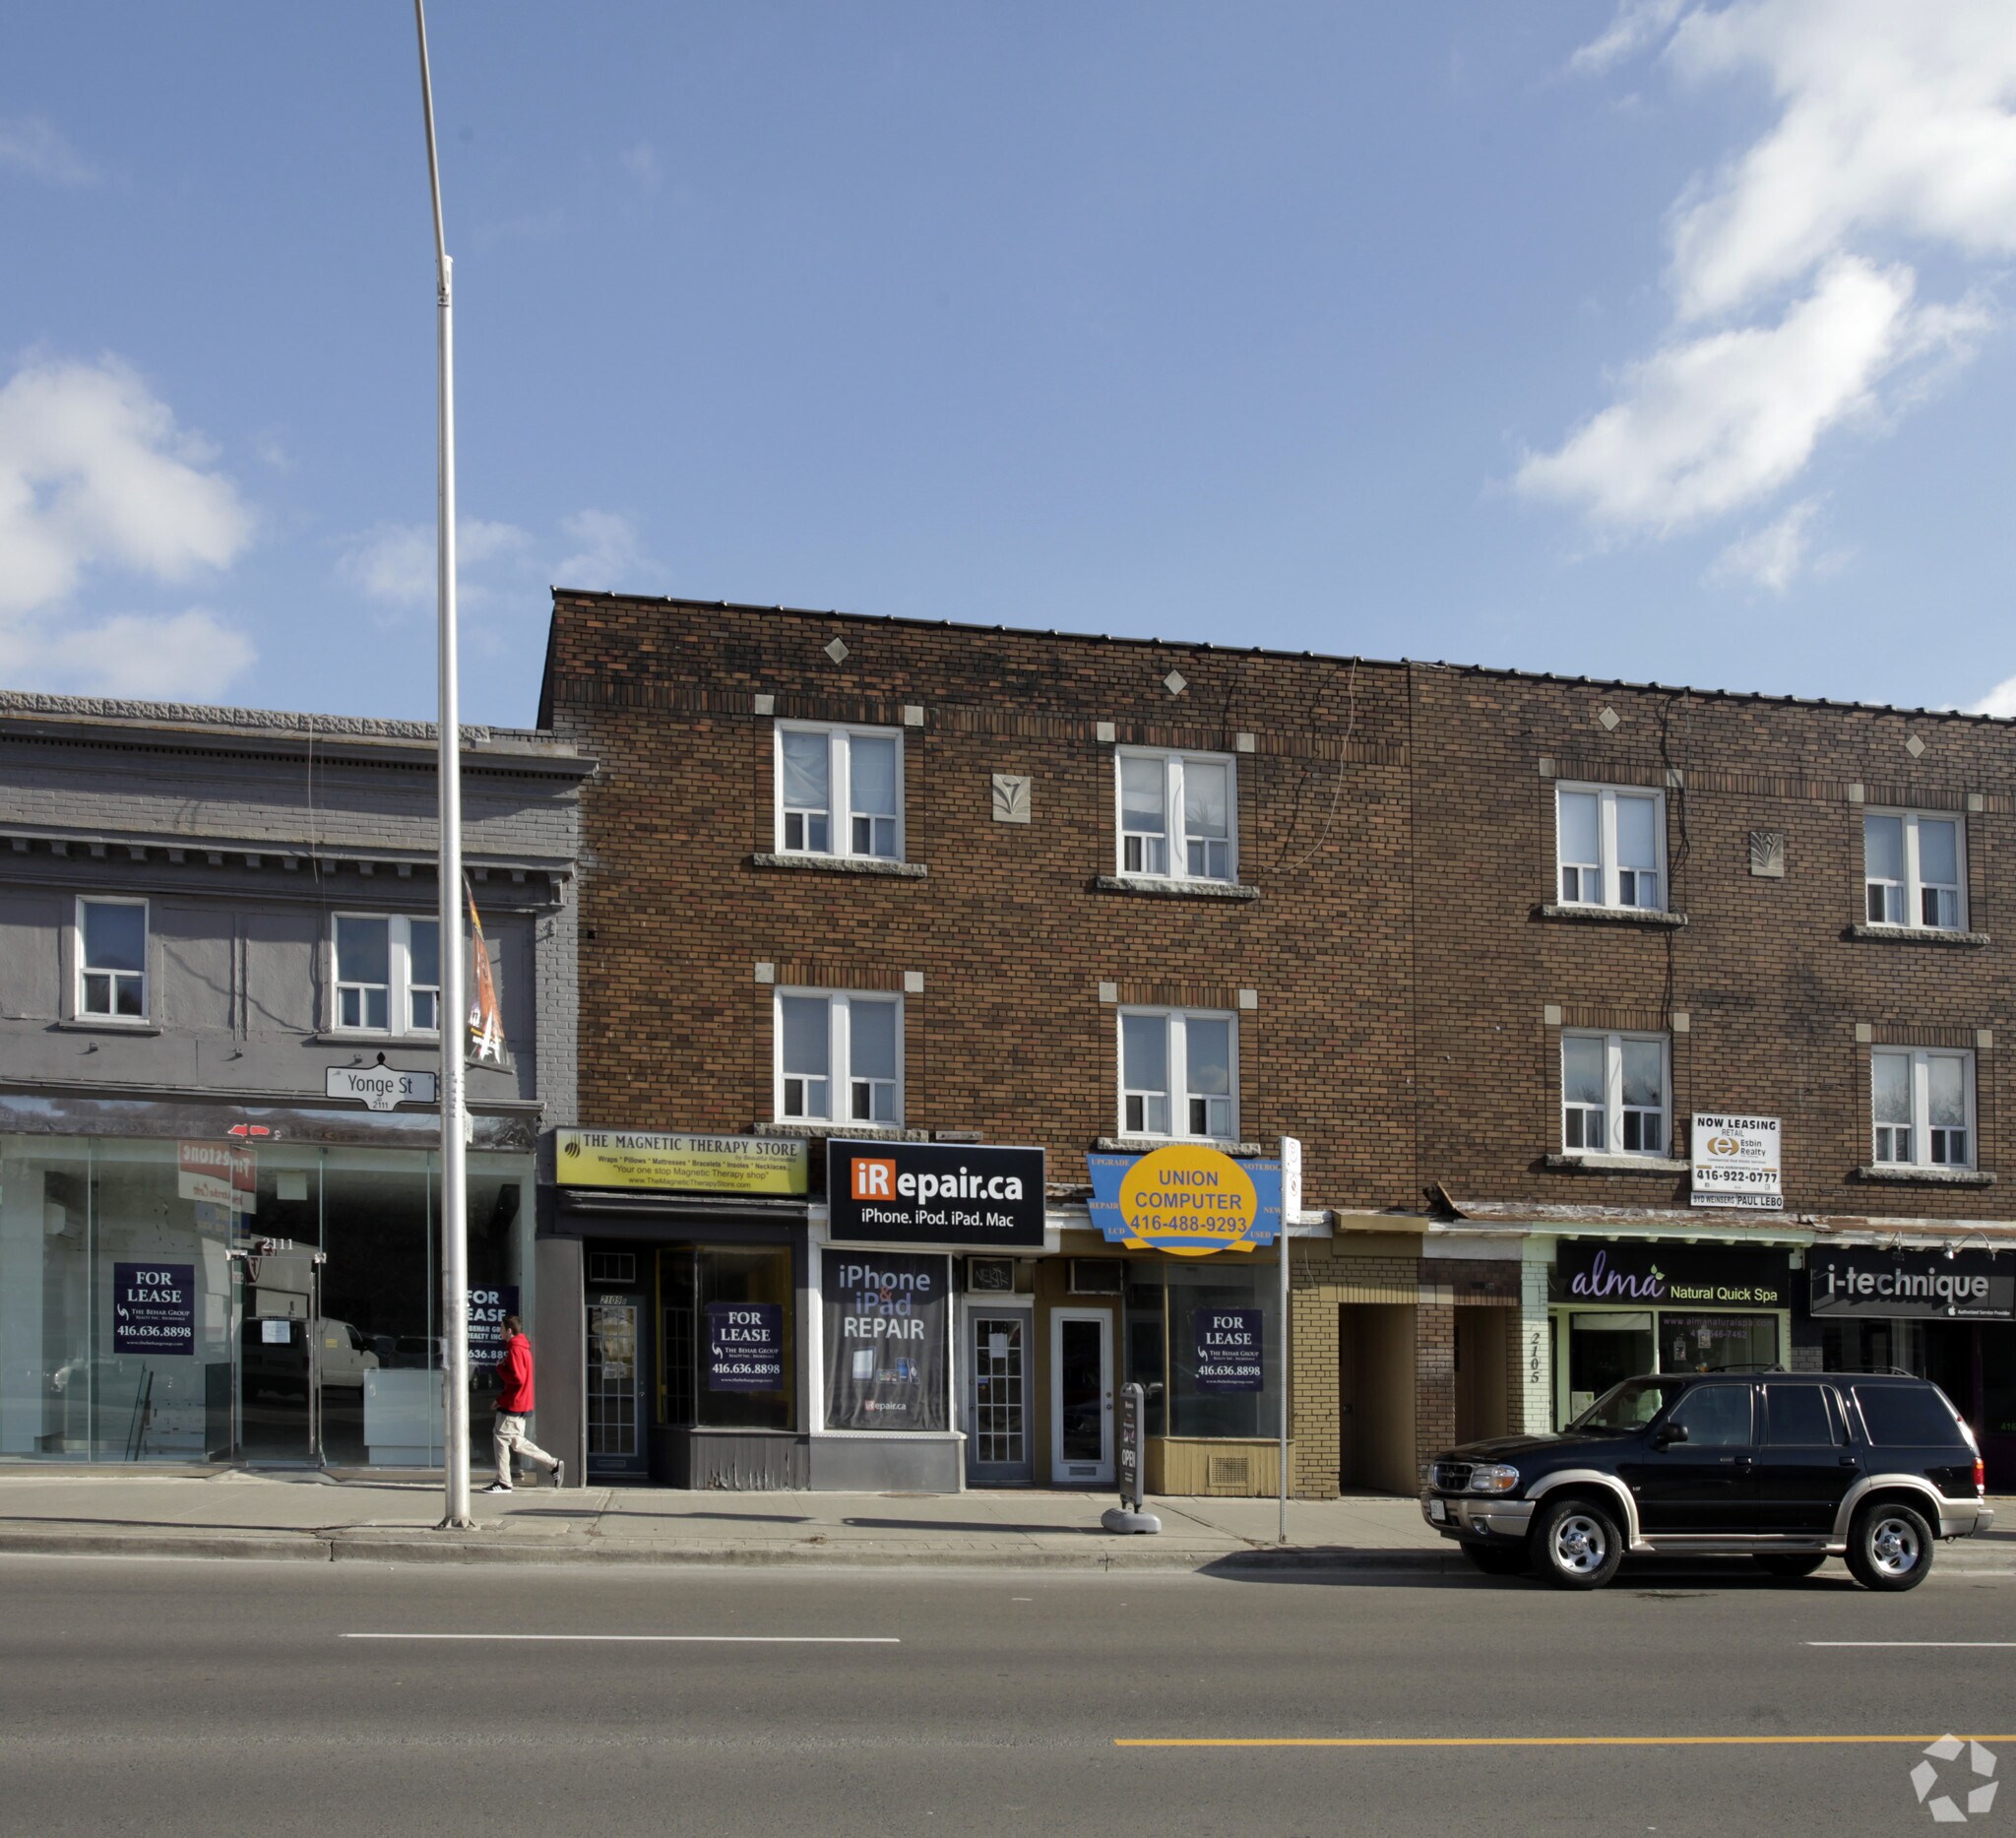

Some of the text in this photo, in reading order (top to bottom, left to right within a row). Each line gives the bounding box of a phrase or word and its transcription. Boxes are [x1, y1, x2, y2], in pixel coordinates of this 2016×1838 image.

[347, 1074, 412, 1097] Yonge St
[373, 1101, 389, 1109] 2111
[1697, 1117, 1776, 1130] NOW LEASING
[583, 1134, 797, 1157] THE MAGNETIC THERAPY STORE
[1740, 1139, 1762, 1148] Esbin
[1740, 1148, 1766, 1157] Realty
[655, 1168, 671, 1176] stop
[673, 1168, 710, 1176] Magnetic
[713, 1169, 744, 1179] Therapy
[1159, 1170, 1219, 1186] UNION
[1697, 1170, 1778, 1183] 416-922-0777
[629, 1176, 751, 1188] www.TheMagneticTherapyStore.com
[858, 1163, 1023, 1205] iRepair.ca
[1135, 1192, 1242, 1210] COMPUTER
[1737, 1197, 1783, 1207] PAUL LEBO
[861, 1208, 1014, 1227] iPhone. iPod. iPad. Mac
[1130, 1215, 1247, 1233] 416-488-9293
[263, 1237, 294, 1250] 2111
[136, 1272, 172, 1285] FOR
[840, 1265, 930, 1291] iPhone
[1572, 1249, 1665, 1298] alma
[1828, 1264, 1989, 1303] i-technique
[127, 1289, 182, 1302] LEASE
[879, 1286, 893, 1302] &
[1670, 1286, 1778, 1302] Natural Quick Spa
[855, 1292, 912, 1316] iPad
[728, 1311, 762, 1325] FOR
[1213, 1316, 1244, 1329] FOR
[117, 1325, 191, 1337] 416.636.8898
[721, 1328, 771, 1342] LEASE
[844, 1317, 924, 1340] REPAIR
[1206, 1332, 1252, 1345] LEASE
[1531, 1333, 1540, 1383] 2105
[712, 1363, 781, 1374] 416.636.8898
[1198, 1365, 1260, 1376] 416.636.8898
[865, 1400, 907, 1414] iRepair.ca
[1122, 1449, 1136, 1468] OPEN
